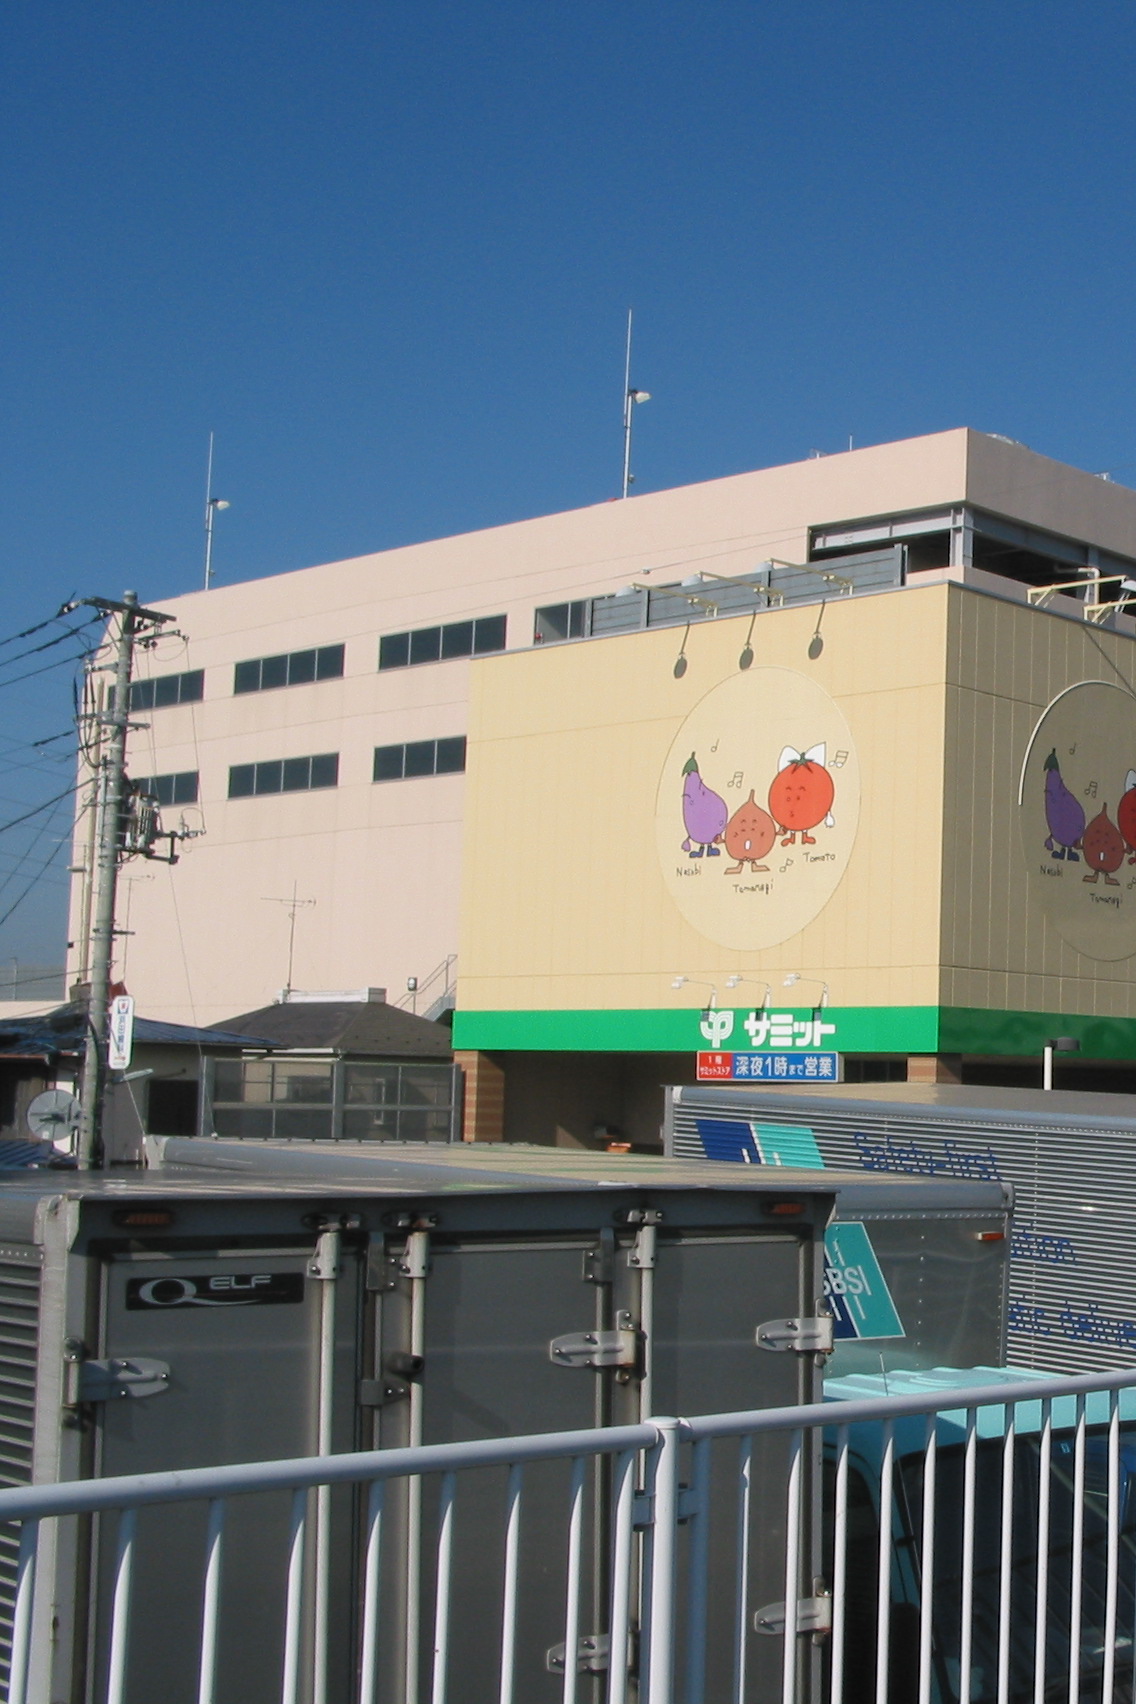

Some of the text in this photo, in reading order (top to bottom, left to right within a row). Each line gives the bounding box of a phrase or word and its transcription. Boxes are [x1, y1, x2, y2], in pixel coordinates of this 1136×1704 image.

[744, 1012, 836, 1047] サミット
[736, 1056, 833, 1078] 深夜1時まで営業
[210, 1275, 272, 1290] ELF
